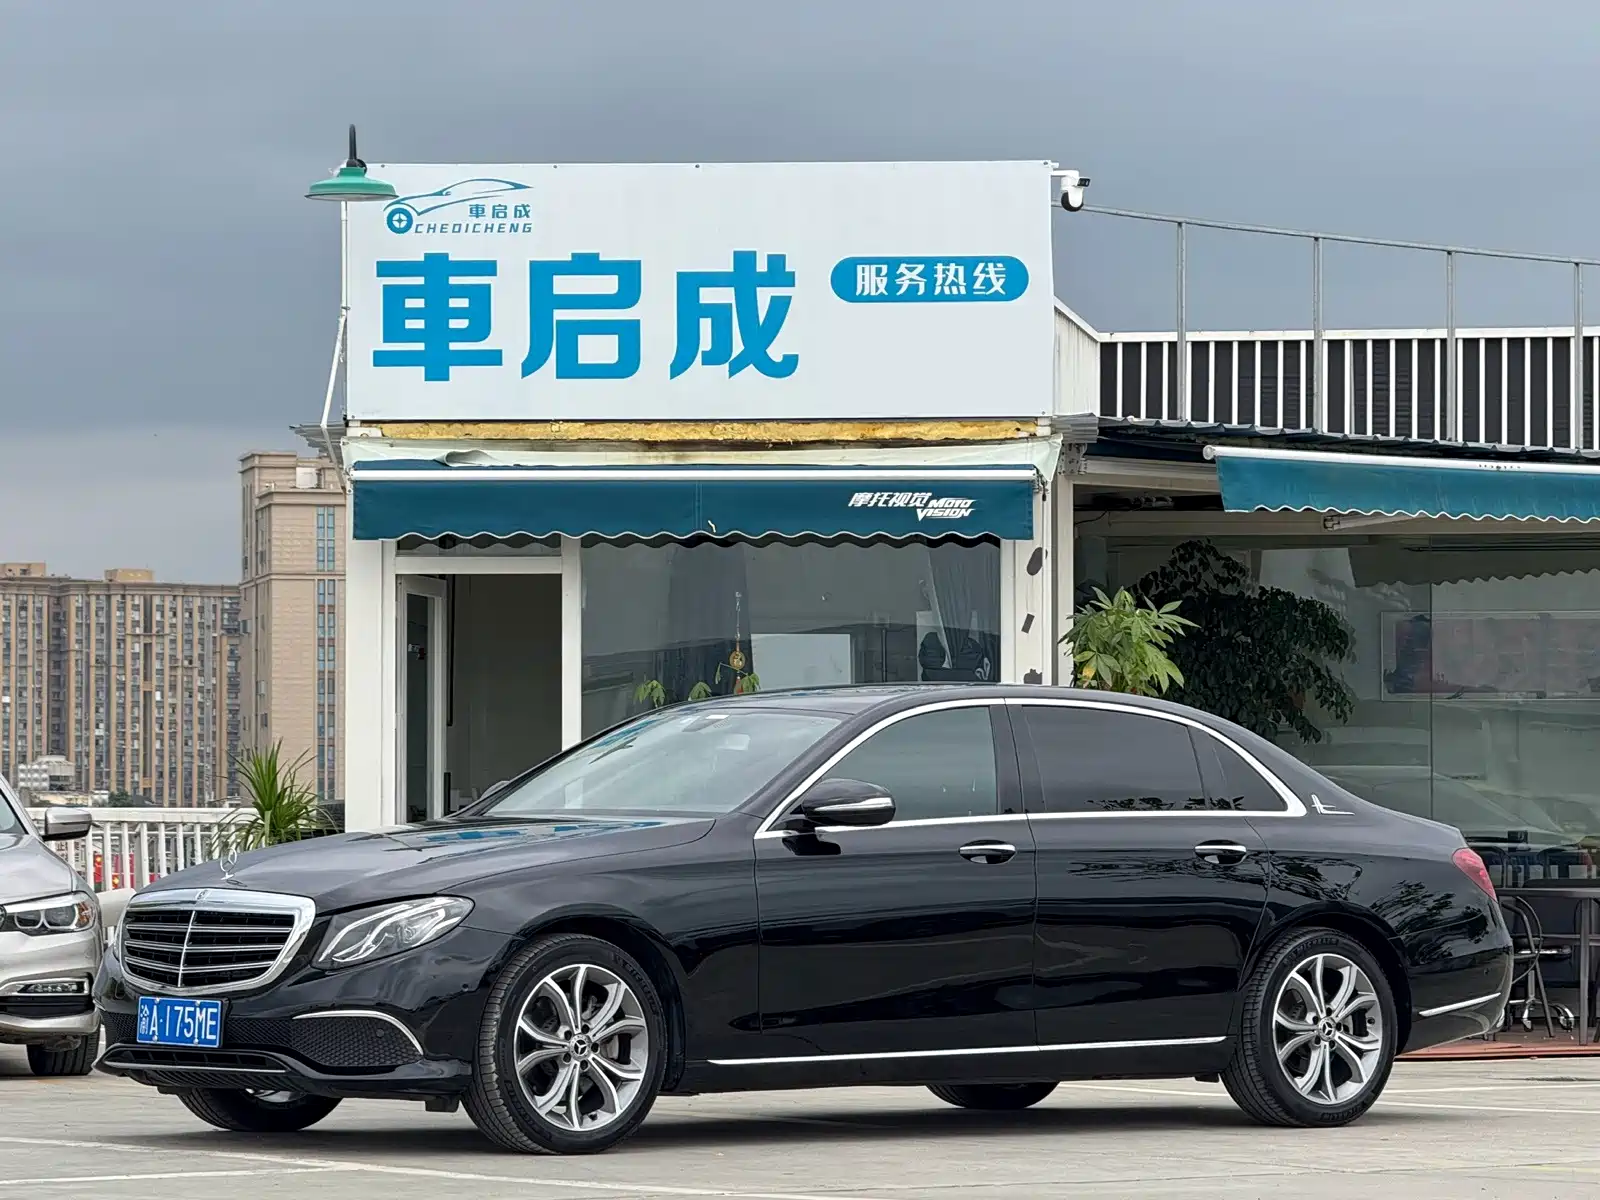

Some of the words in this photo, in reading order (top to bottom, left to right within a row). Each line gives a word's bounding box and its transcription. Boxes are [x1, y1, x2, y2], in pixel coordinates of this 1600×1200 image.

[469, 204, 530, 218] 車启成
[855, 262, 1007, 296] 服务热线
[373, 250, 800, 382] 車启成
[847, 491, 933, 507] 摩托视觉
